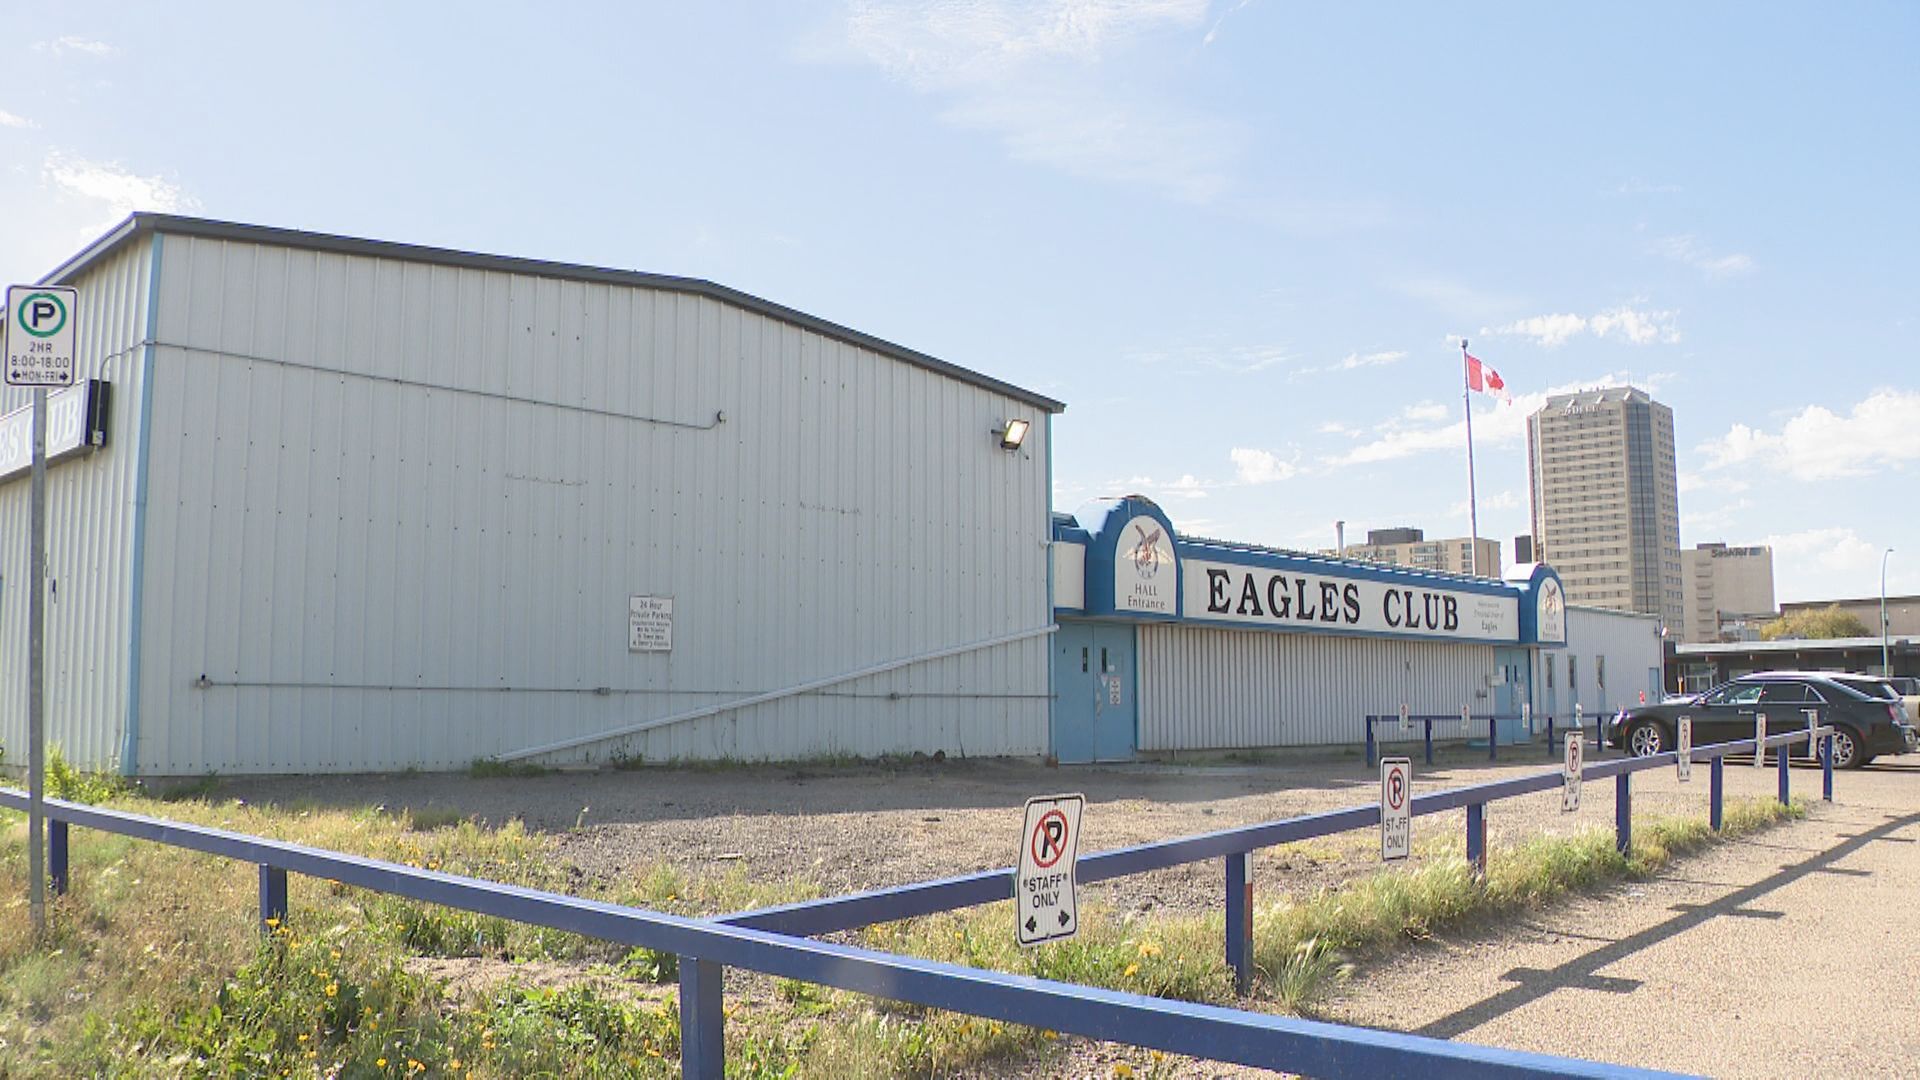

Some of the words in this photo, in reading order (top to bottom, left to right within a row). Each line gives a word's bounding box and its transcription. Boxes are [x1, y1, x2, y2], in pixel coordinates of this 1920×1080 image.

[11, 355, 70, 368] 8:00-18:00
[21, 369, 59, 381] MON-FRI
[1135, 583, 1158, 597] HALL
[1128, 595, 1166, 610] Entrance
[1206, 568, 1361, 624] EAGLES
[1383, 588, 1458, 631] CLUB
[1386, 834, 1405, 849] ONLY
[1029, 873, 1062, 892] STAFF
[1032, 891, 1060, 909] ONLY
